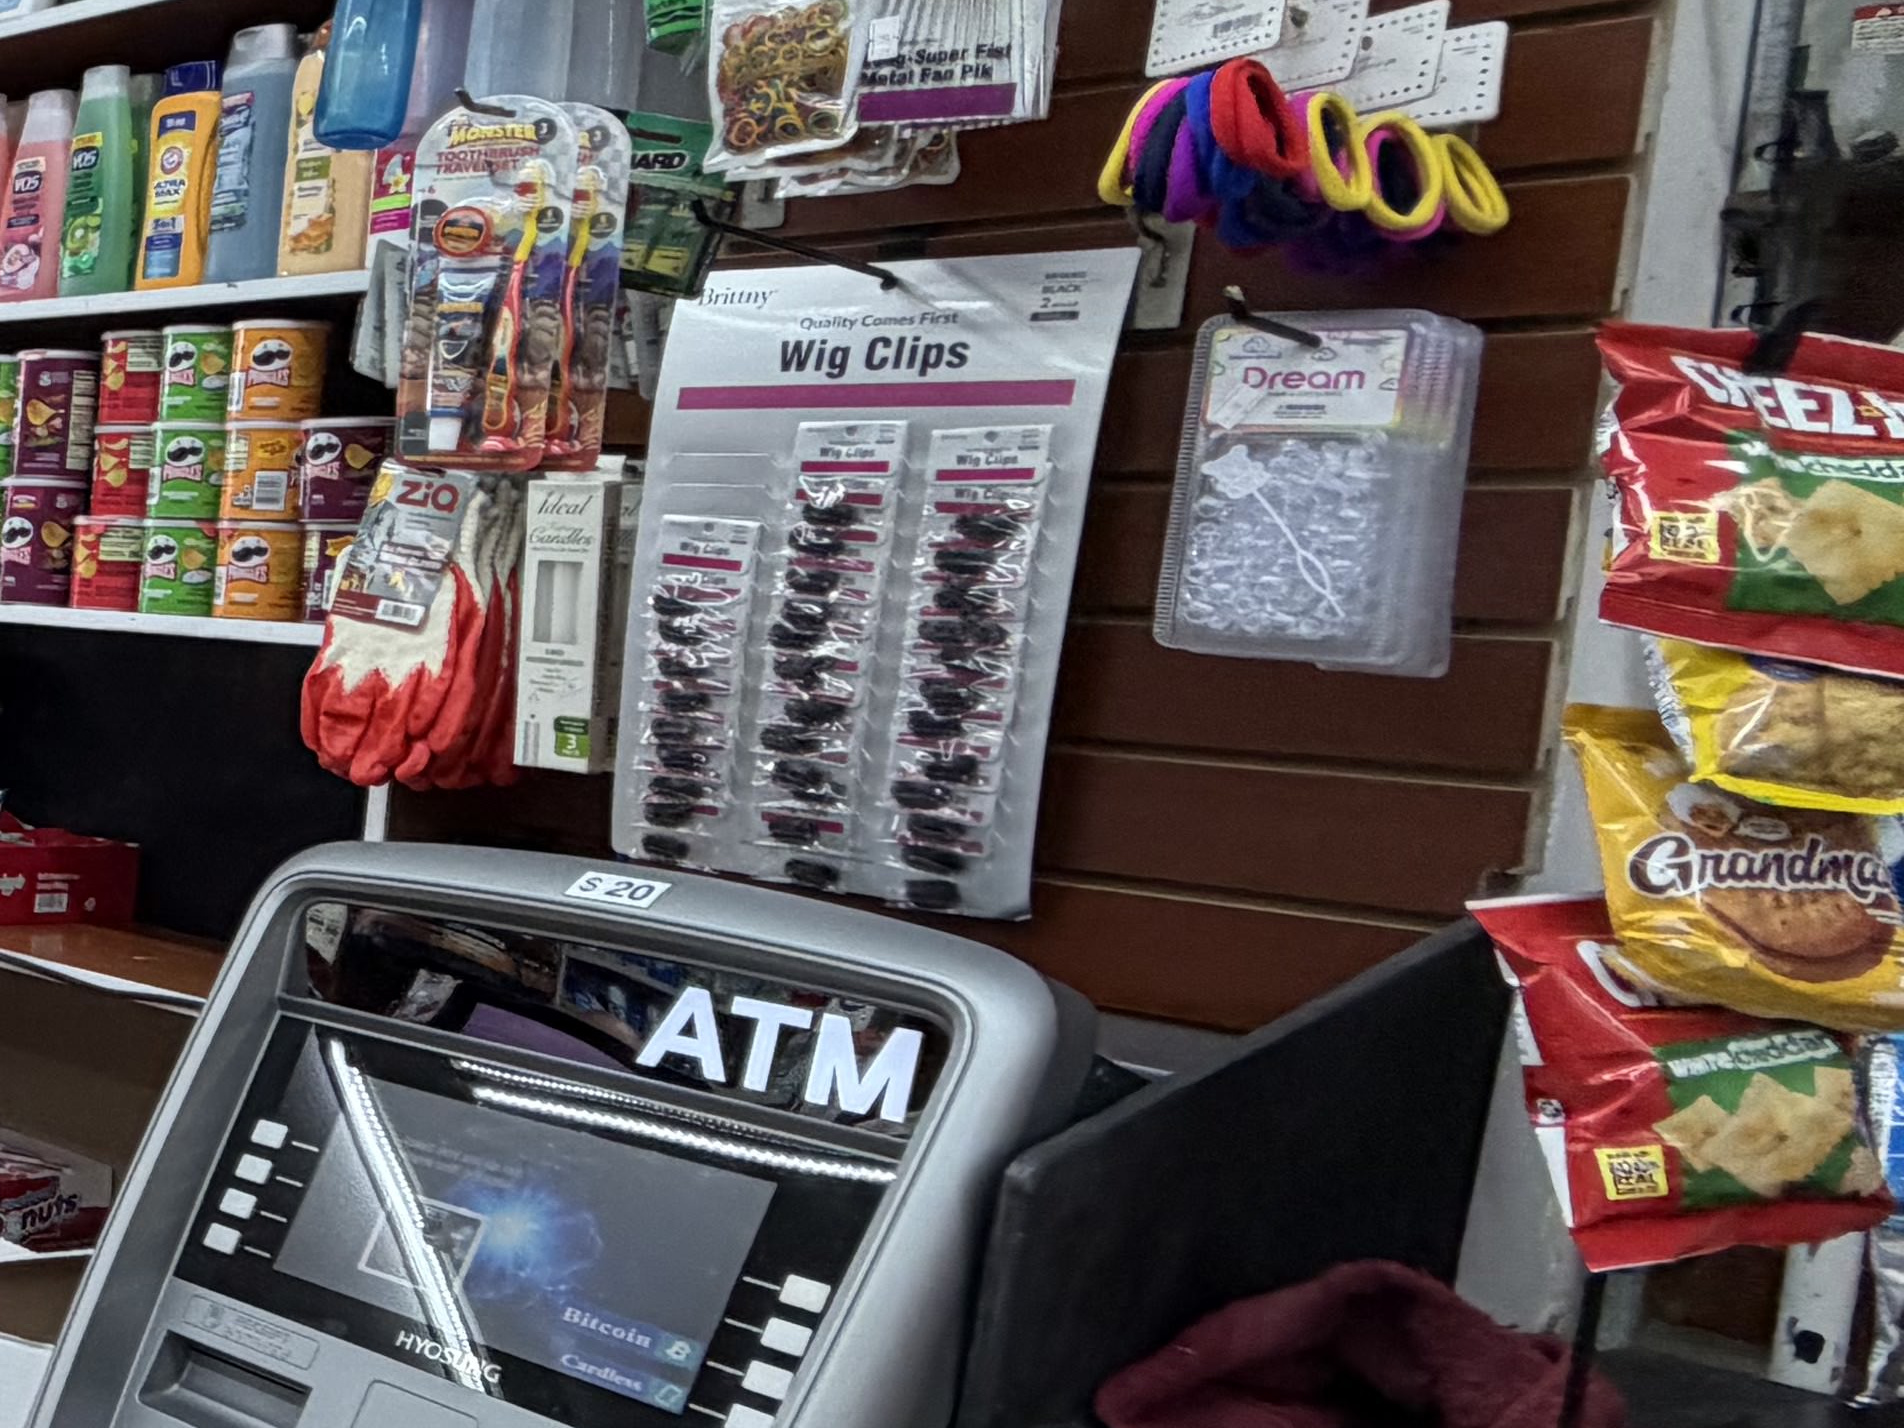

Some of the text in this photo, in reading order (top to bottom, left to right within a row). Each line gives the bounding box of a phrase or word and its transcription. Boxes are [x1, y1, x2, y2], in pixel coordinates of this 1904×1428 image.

[698, 287, 773, 310] Brittny
[1041, 283, 1082, 294] BLACK
[800, 310, 959, 331] Quality Comes First
[779, 334, 971, 379] Wig Clips
[1242, 366, 1365, 390] Dream
[818, 446, 876, 460] Wig Clips
[956, 452, 1019, 467] Wig Clips
[537, 491, 594, 517] Ideal
[528, 527, 595, 548] Candles
[566, 733, 578, 750] 3
[579, 877, 656, 902] $ 20
[635, 985, 924, 1125] ATM
[561, 1305, 653, 1351] Bitcoin
[560, 1352, 643, 1394] Cardless
